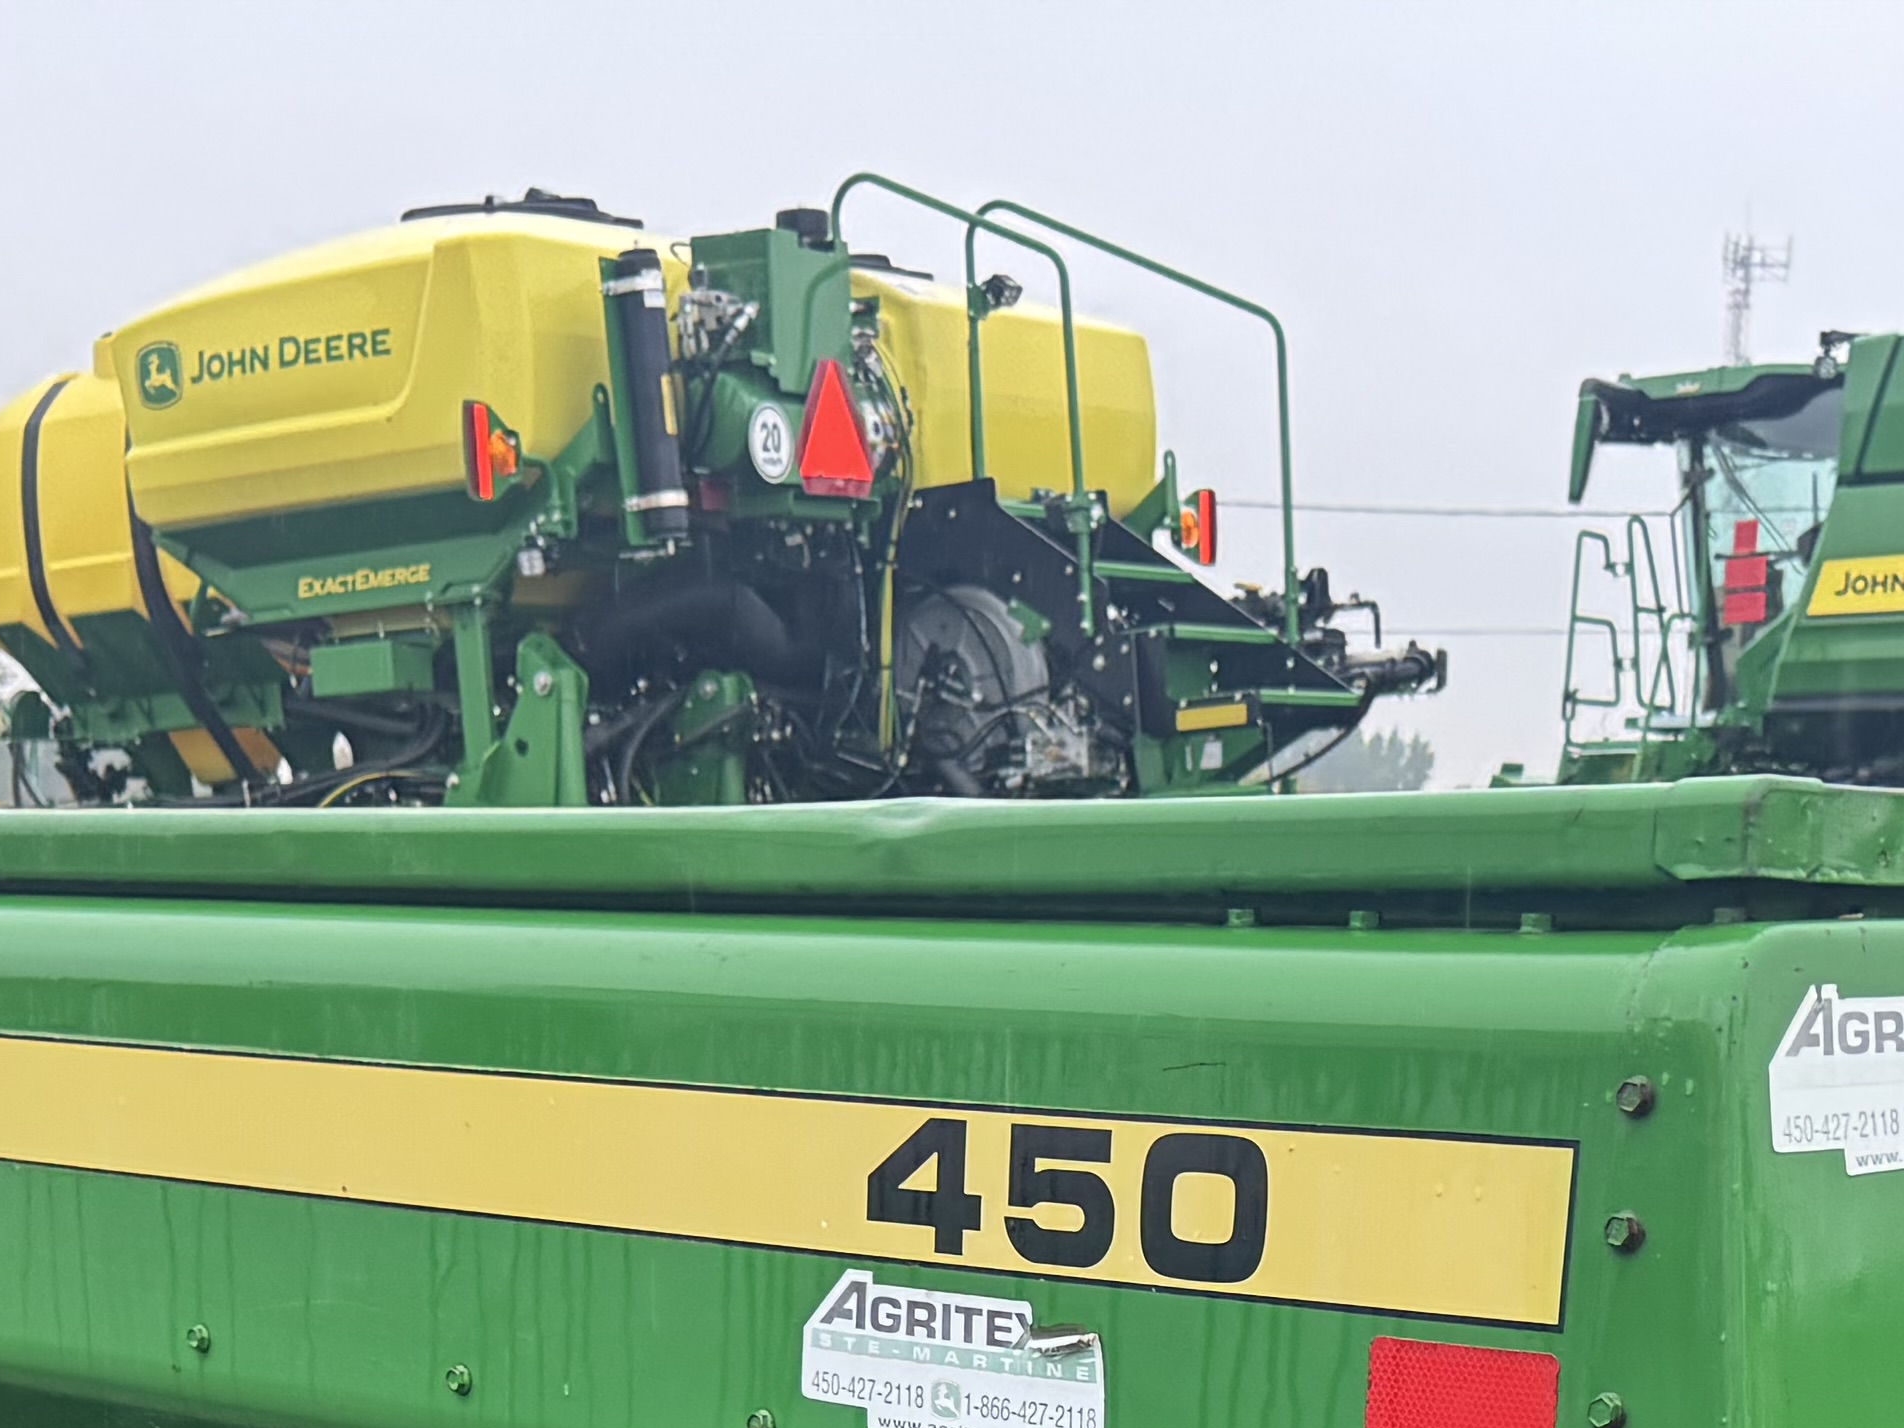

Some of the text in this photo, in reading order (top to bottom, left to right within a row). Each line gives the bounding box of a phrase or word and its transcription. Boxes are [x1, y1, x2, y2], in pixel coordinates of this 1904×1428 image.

[190, 328, 391, 384] JOHN DEERE
[760, 421, 781, 453] 20
[1783, 1108, 1900, 1143] 450-427-2118
[866, 1118, 1268, 1283] 450
[812, 1369, 924, 1408] 450-427-2118
